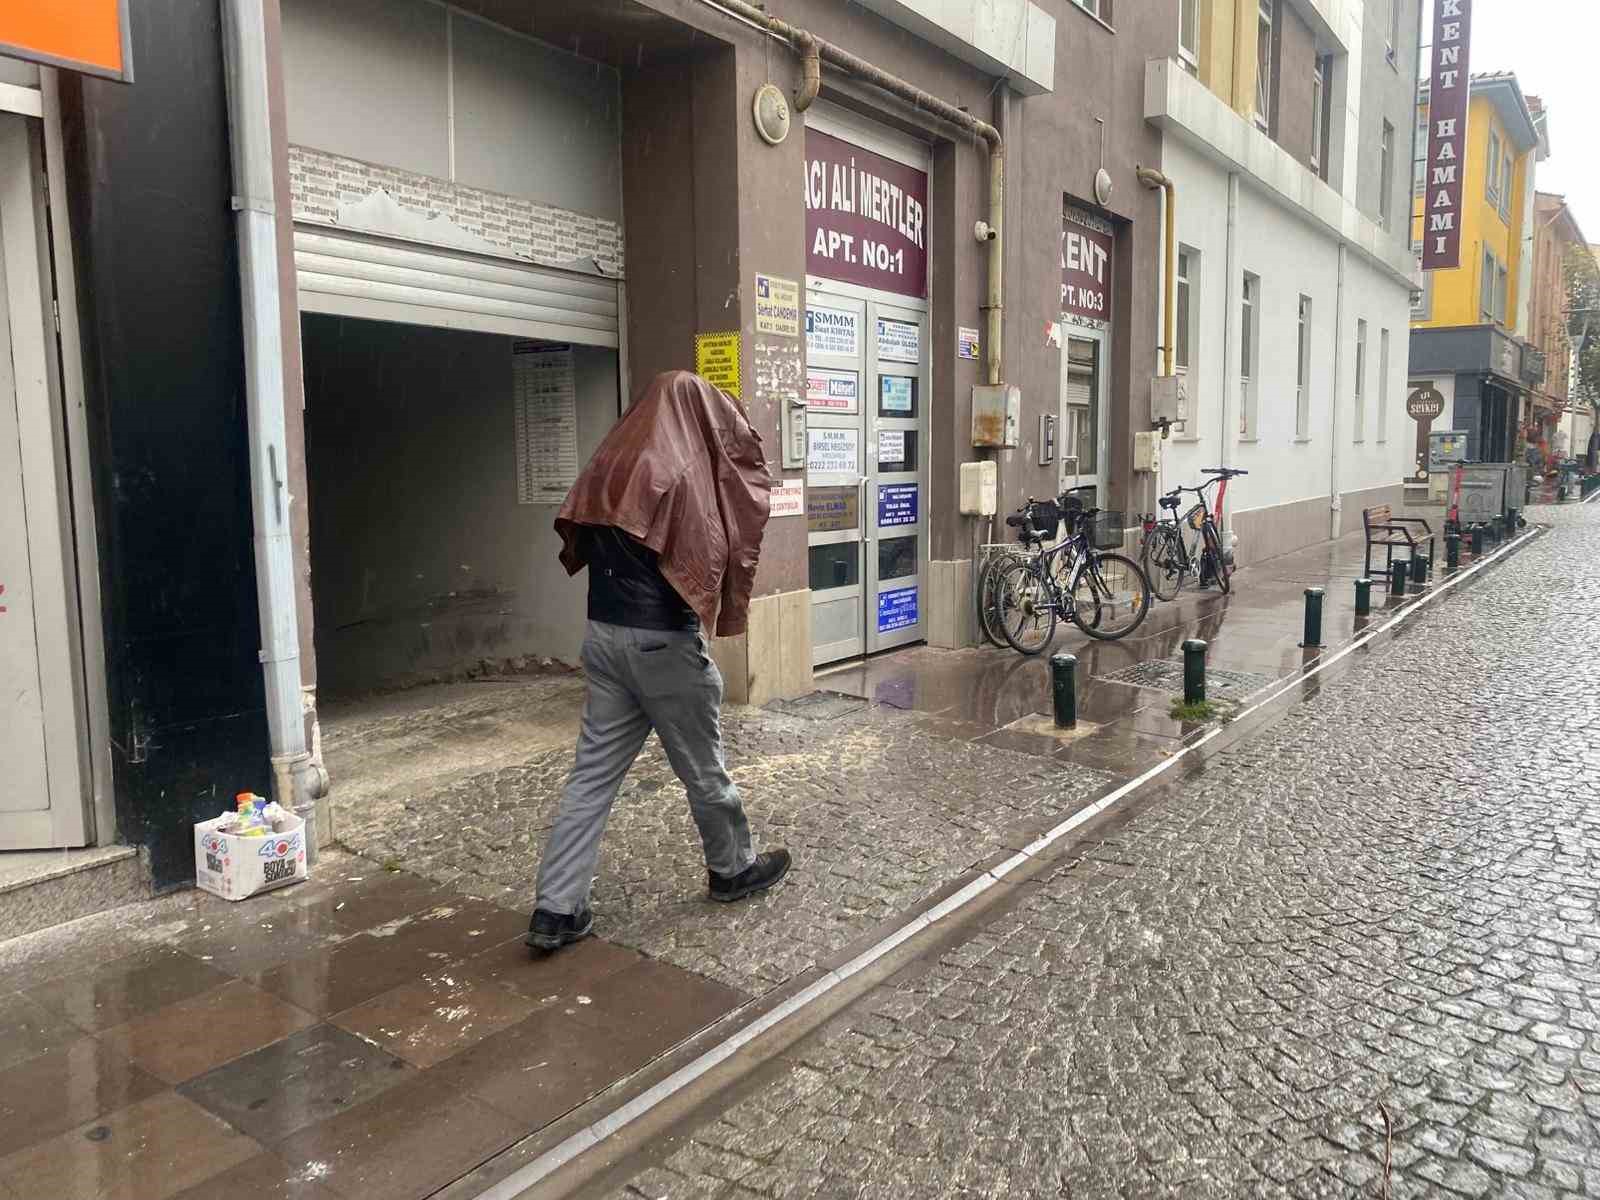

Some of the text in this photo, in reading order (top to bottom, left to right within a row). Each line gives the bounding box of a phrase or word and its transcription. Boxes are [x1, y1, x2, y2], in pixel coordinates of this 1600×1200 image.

[1430, 0, 1461, 254] KENT HAMAMI
[831, 157, 856, 213] ALİ
[860, 171, 923, 249] MERTLER
[813, 227, 903, 274] APT. NO:1
[815, 312, 854, 327] SMMM
[1079, 288, 1103, 311] NO:3
